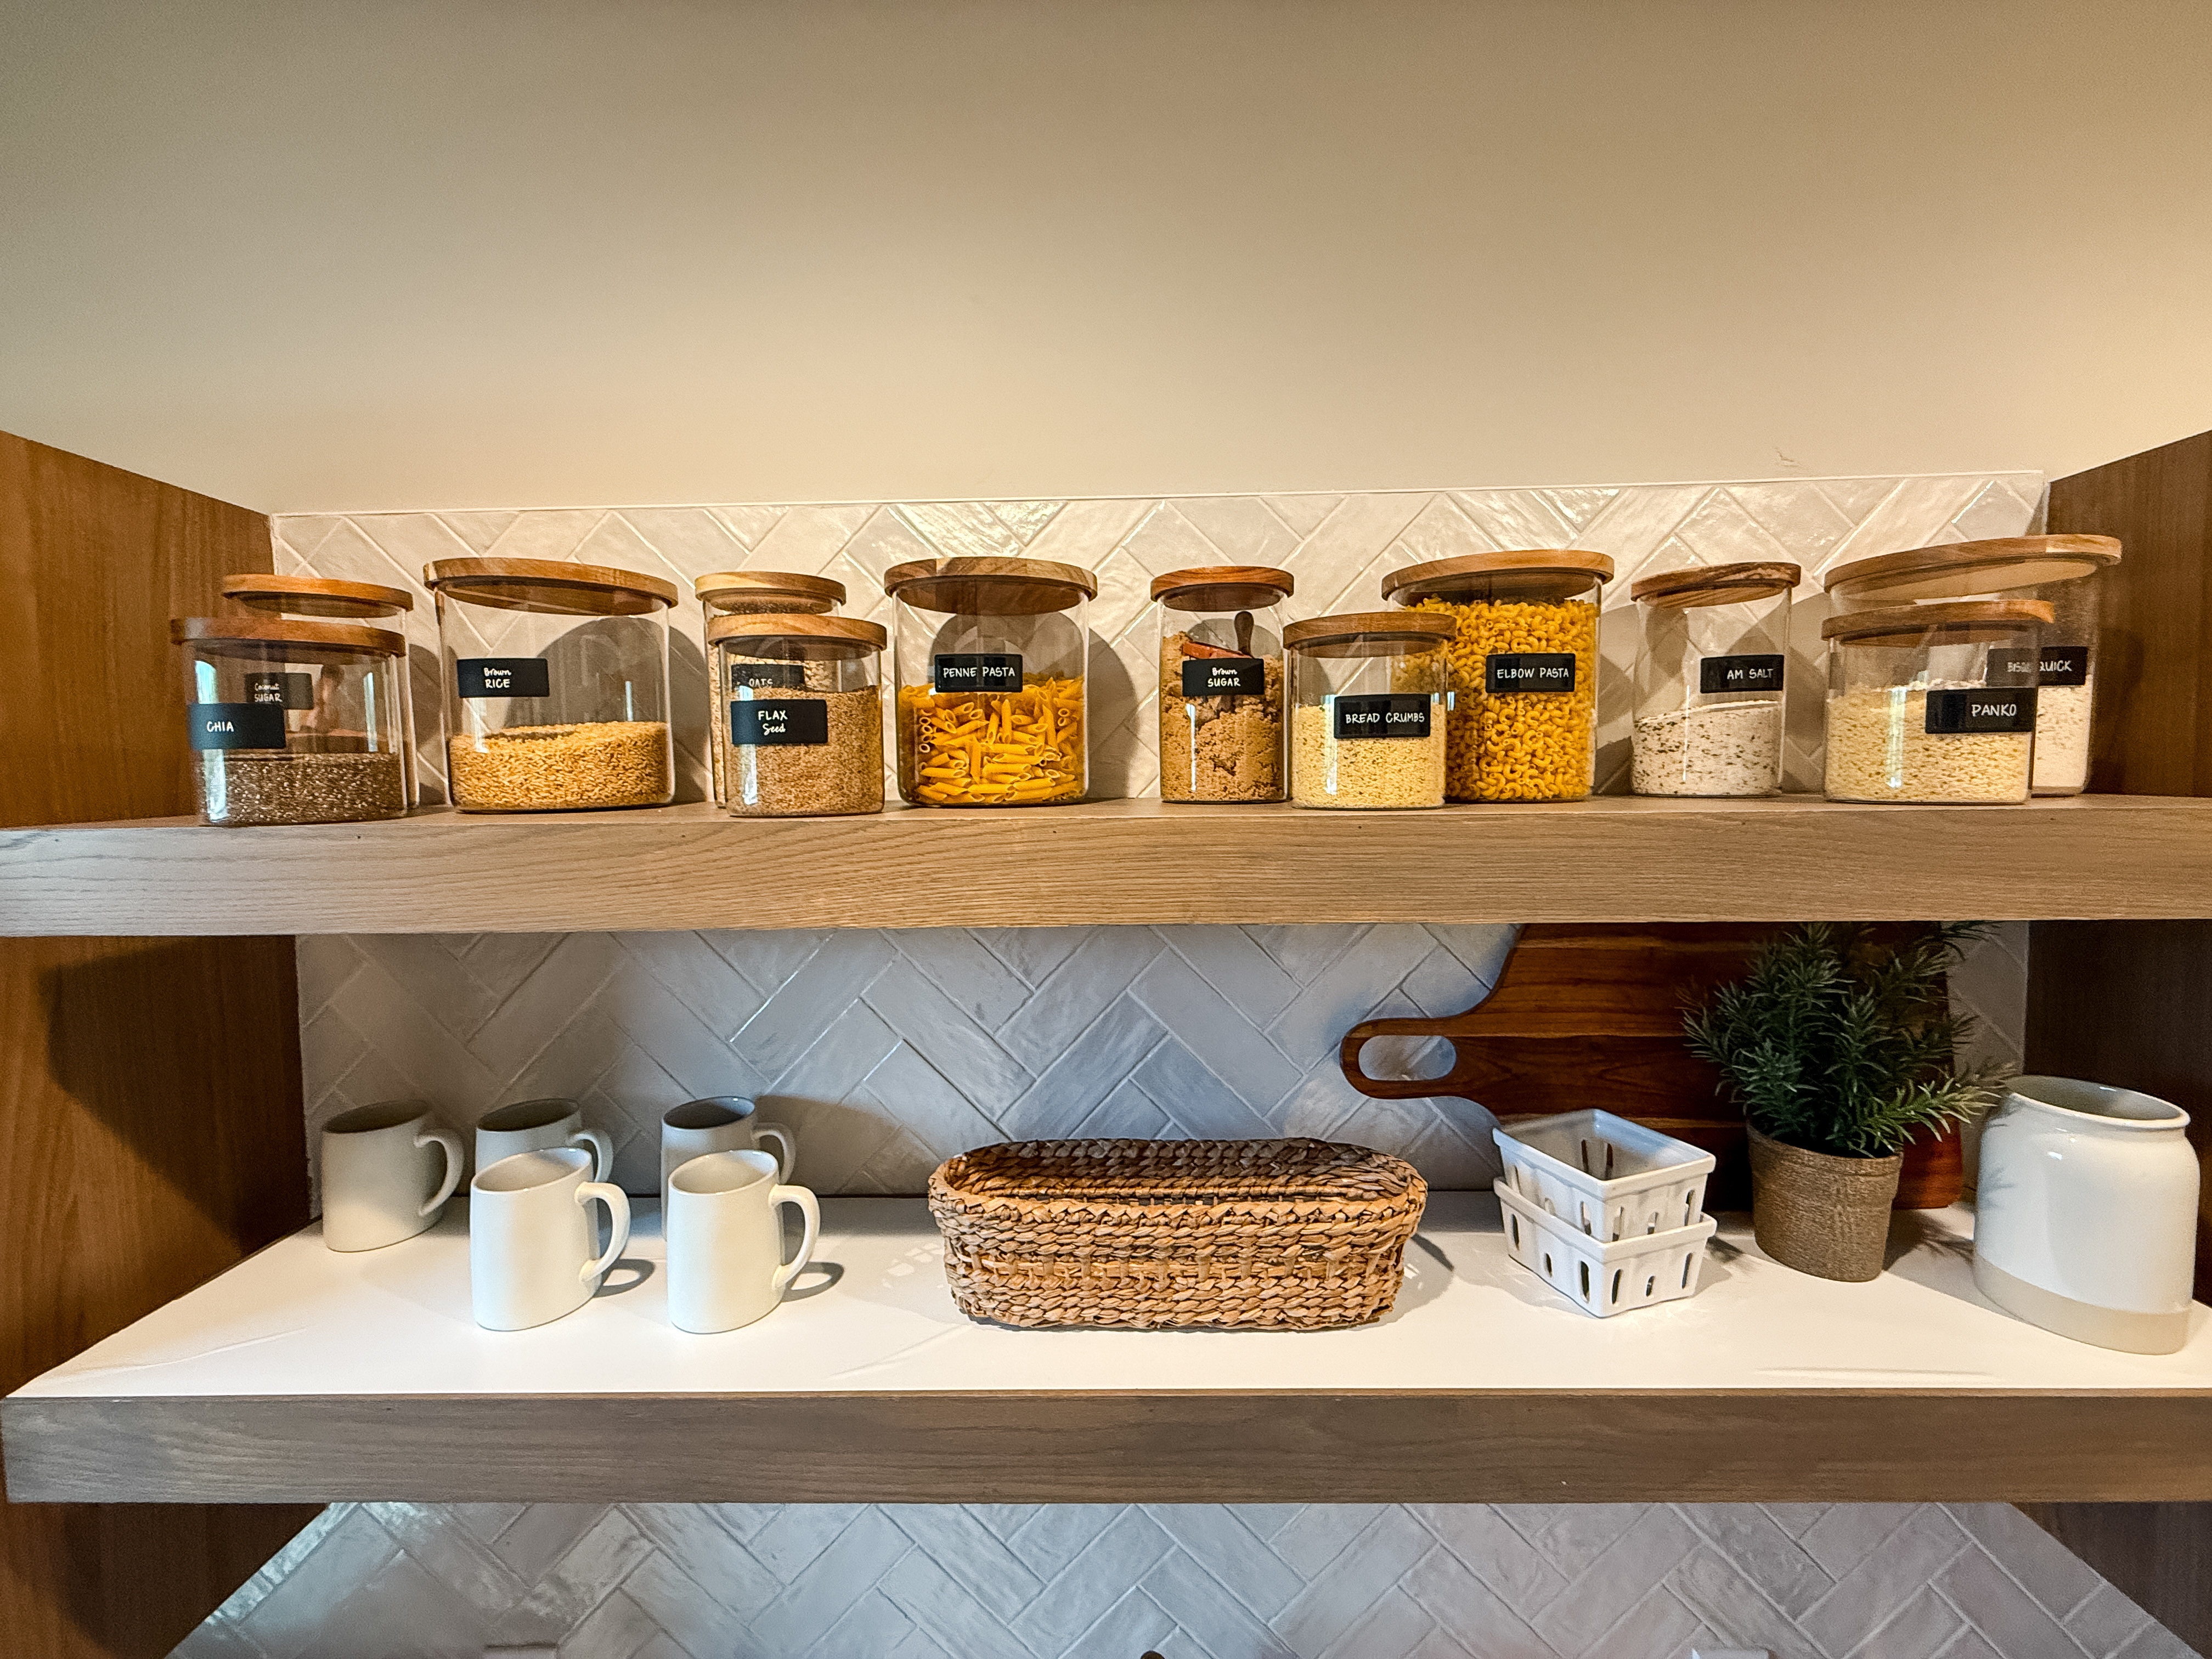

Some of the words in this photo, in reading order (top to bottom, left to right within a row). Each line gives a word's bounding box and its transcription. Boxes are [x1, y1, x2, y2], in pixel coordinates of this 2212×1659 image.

[484, 667, 512, 676] Brown
[943, 667, 977, 678] PENNE
[983, 667, 1015, 677] PASTA
[1212, 667, 1238, 676] Brown
[1497, 668, 1534, 679] ELBOW
[1539, 667, 1569, 678] PASTA
[1749, 668, 1774, 679] SALT
[485, 678, 511, 689] RICE
[1207, 678, 1241, 687] SUGAR
[254, 693, 283, 702] SUGAR
[758, 710, 788, 721] FLAX
[1971, 704, 2017, 717] PANKO
[1345, 713, 1380, 724] BREAD
[1385, 712, 1425, 724] CRUMBS
[206, 721, 234, 732] CHIA
[762, 723, 786, 736] Seed
